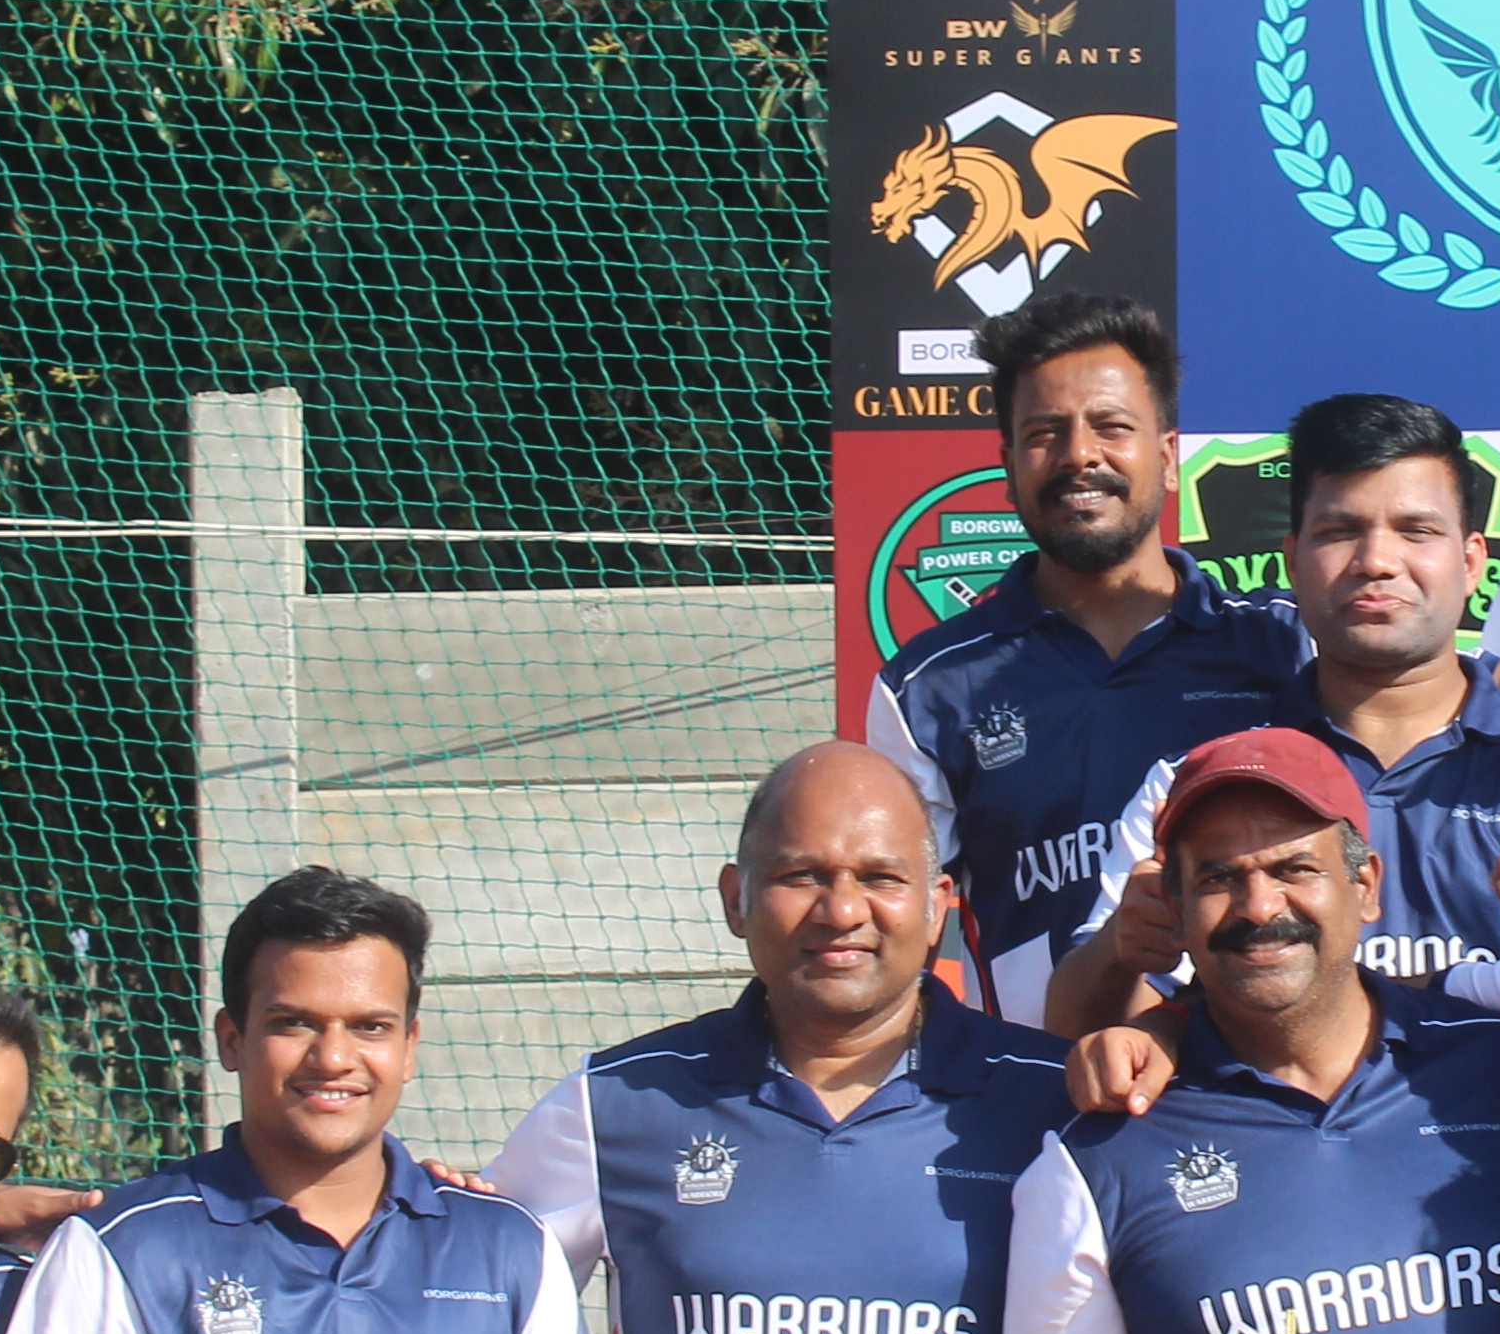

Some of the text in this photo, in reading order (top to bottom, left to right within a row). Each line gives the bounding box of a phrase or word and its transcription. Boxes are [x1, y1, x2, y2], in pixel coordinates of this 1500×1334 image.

[946, 20, 1008, 39] BW
[885, 49, 992, 66] SUPER
[911, 343, 974, 360] BOR
[854, 384, 997, 417] GAME C
[922, 551, 993, 571] POWER
